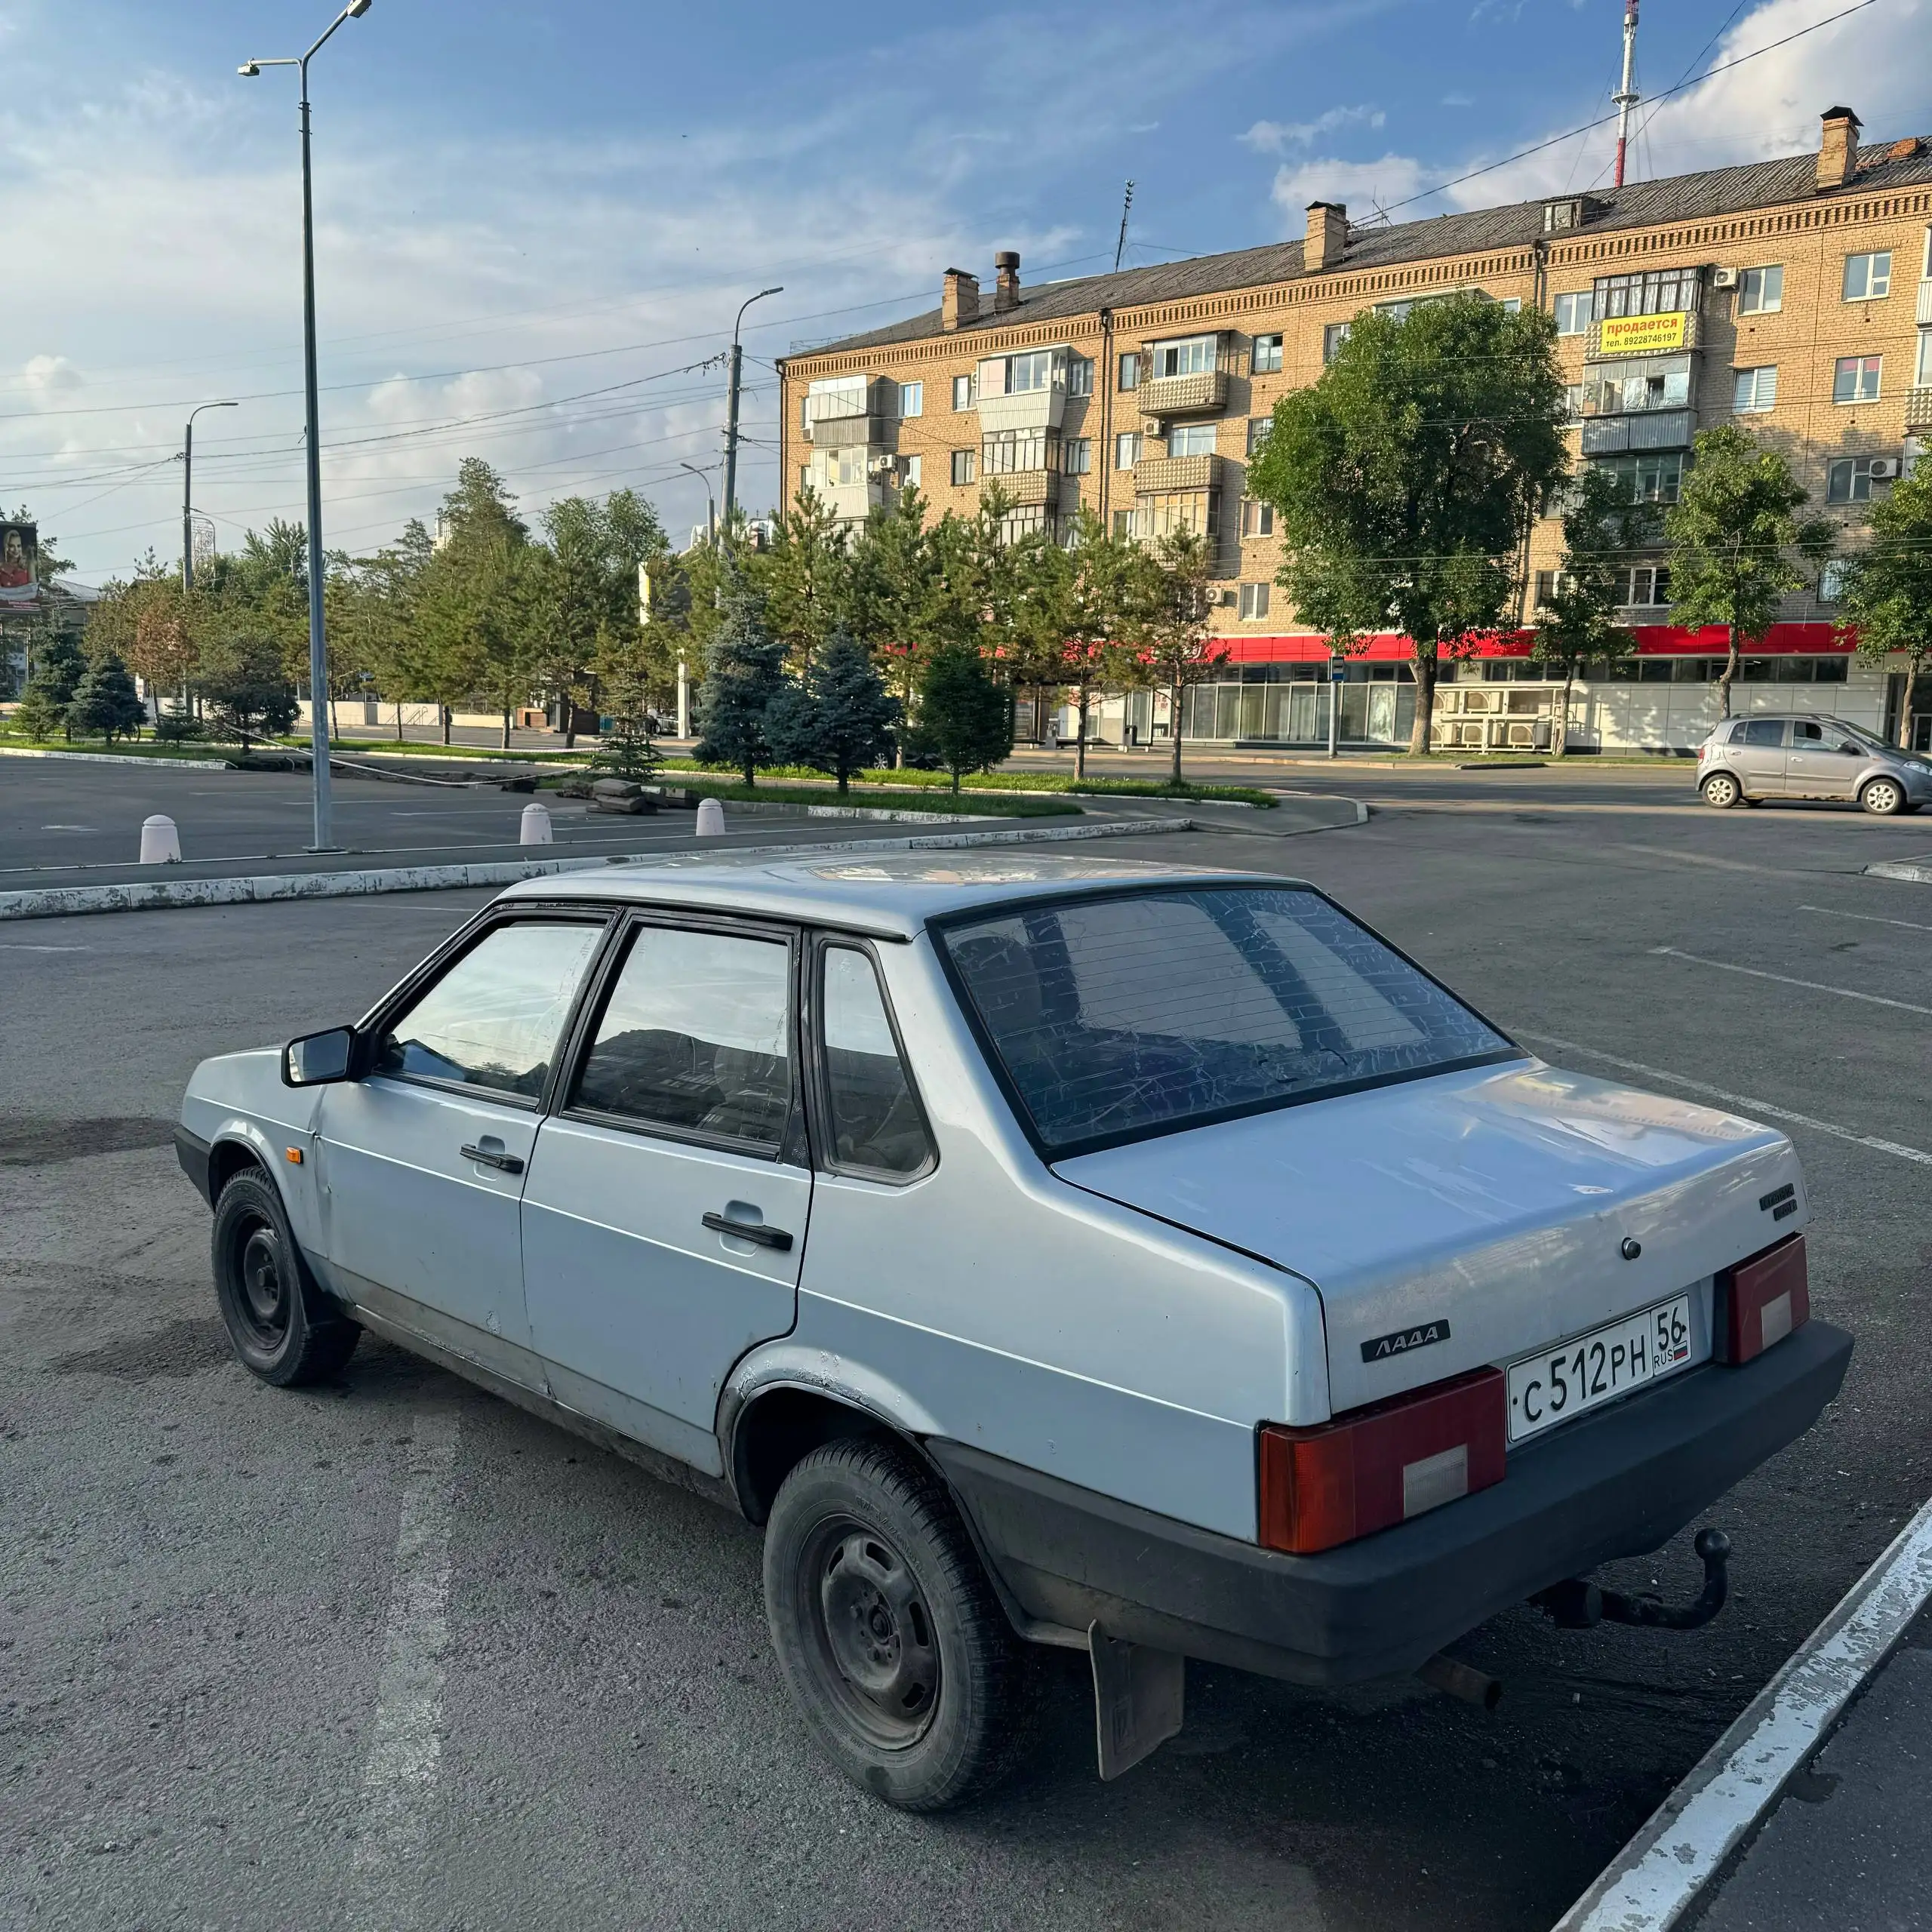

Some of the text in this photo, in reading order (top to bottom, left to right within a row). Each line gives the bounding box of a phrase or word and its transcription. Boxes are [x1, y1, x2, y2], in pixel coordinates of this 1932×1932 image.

[1607, 318, 1678, 337] продается
[1624, 333, 1677, 346] 89228746197
[1657, 1306, 1682, 1350] 56
[1376, 1326, 1438, 1356] ЛАДА
[1654, 1349, 1674, 1369] RUS
